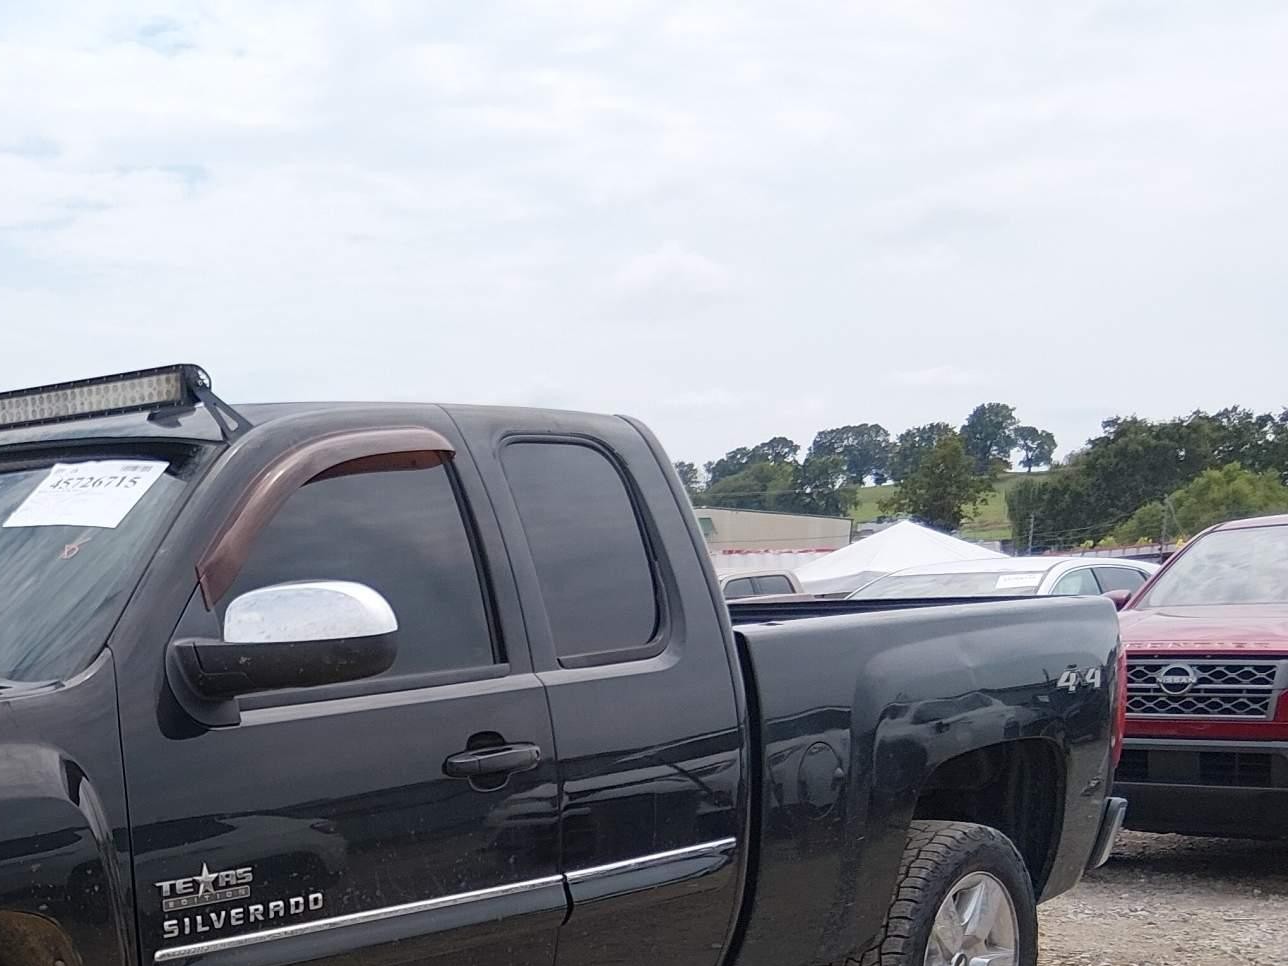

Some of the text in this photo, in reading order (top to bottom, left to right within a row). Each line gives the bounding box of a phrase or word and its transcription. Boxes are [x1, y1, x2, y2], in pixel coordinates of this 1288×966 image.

[50, 475, 142, 489] 45726715
[1156, 676, 1197, 684] NISSAN
[154, 862, 253, 898] TEXAS
[167, 889, 247, 908] EDITION
[163, 893, 324, 939] SILVERADO
